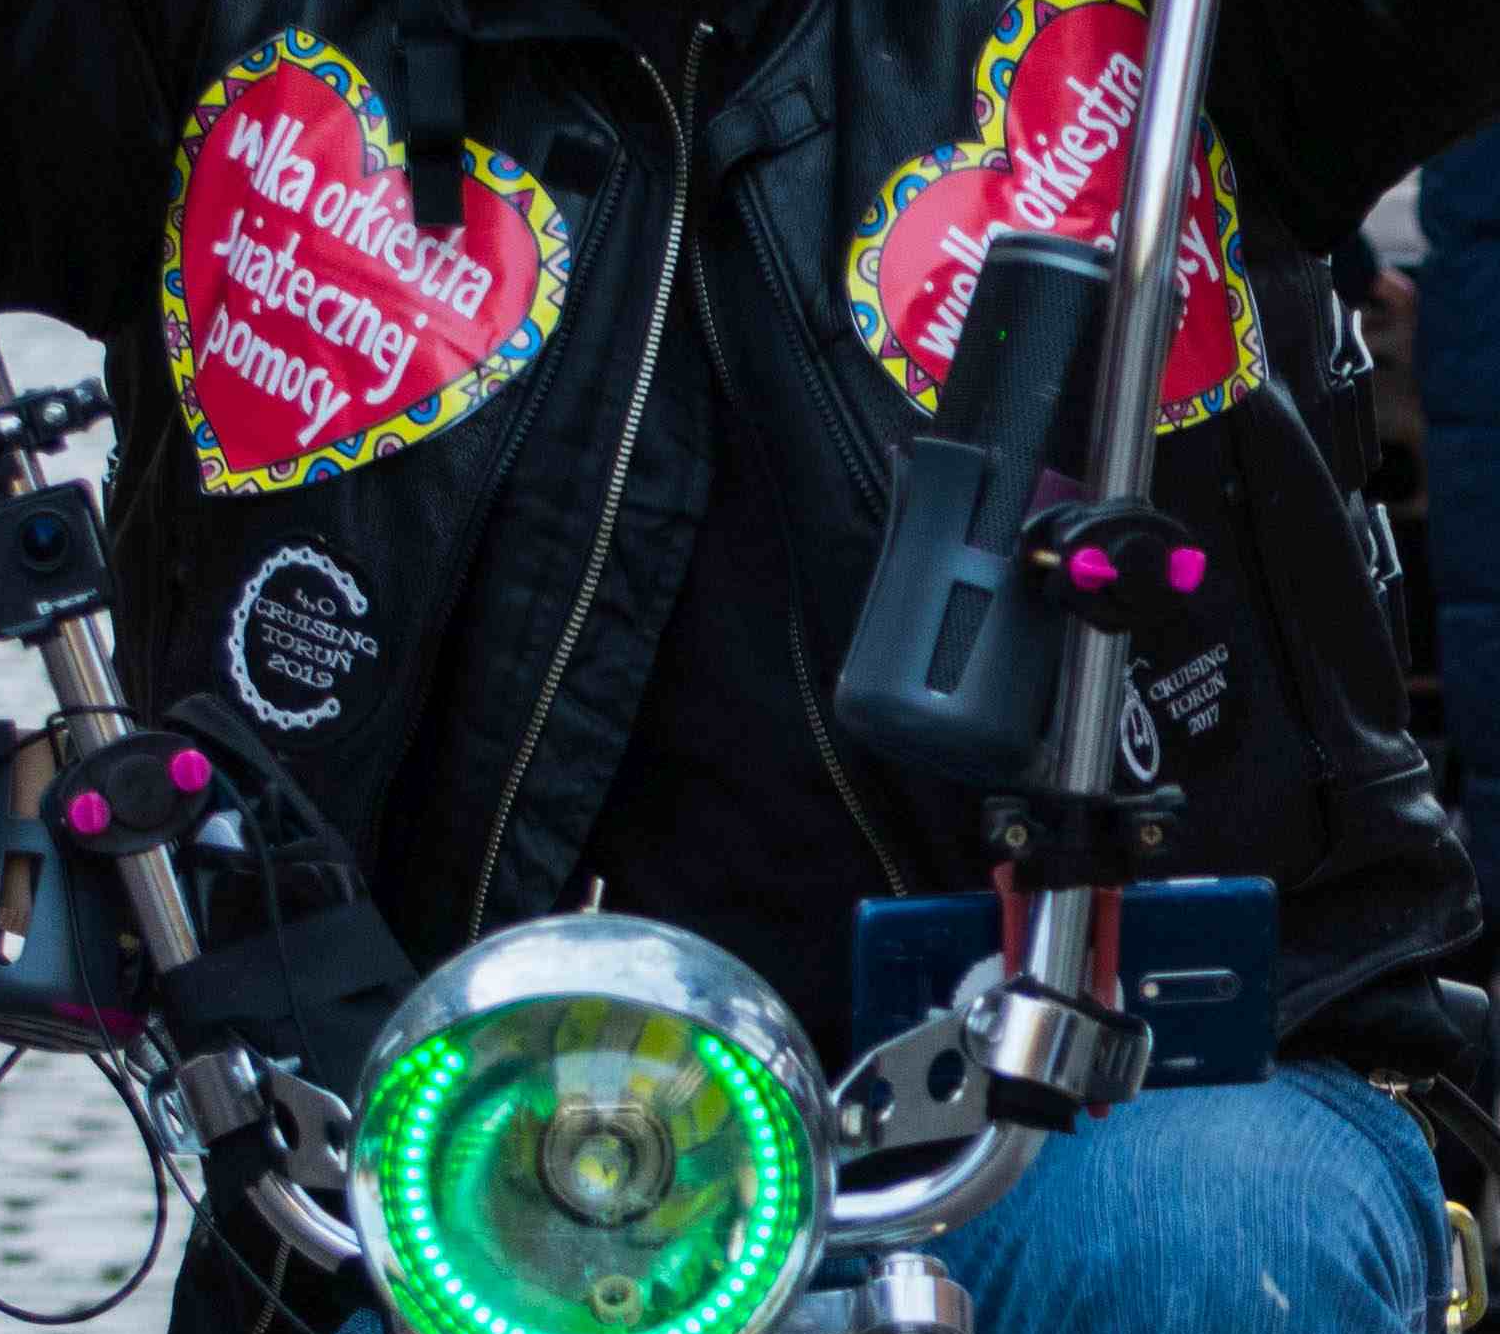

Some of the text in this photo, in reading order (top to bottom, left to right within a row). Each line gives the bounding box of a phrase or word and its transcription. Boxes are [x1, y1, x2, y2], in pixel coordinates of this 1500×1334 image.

[1013, 51, 1144, 230] orkiestra
[312, 177, 492, 320] orkiestra
[199, 302, 353, 448] pomocy
[255, 597, 379, 658] CRUISING
[267, 653, 335, 688] 2019
[1149, 642, 1229, 702] CRUISING
[1188, 703, 1220, 736] 2017
